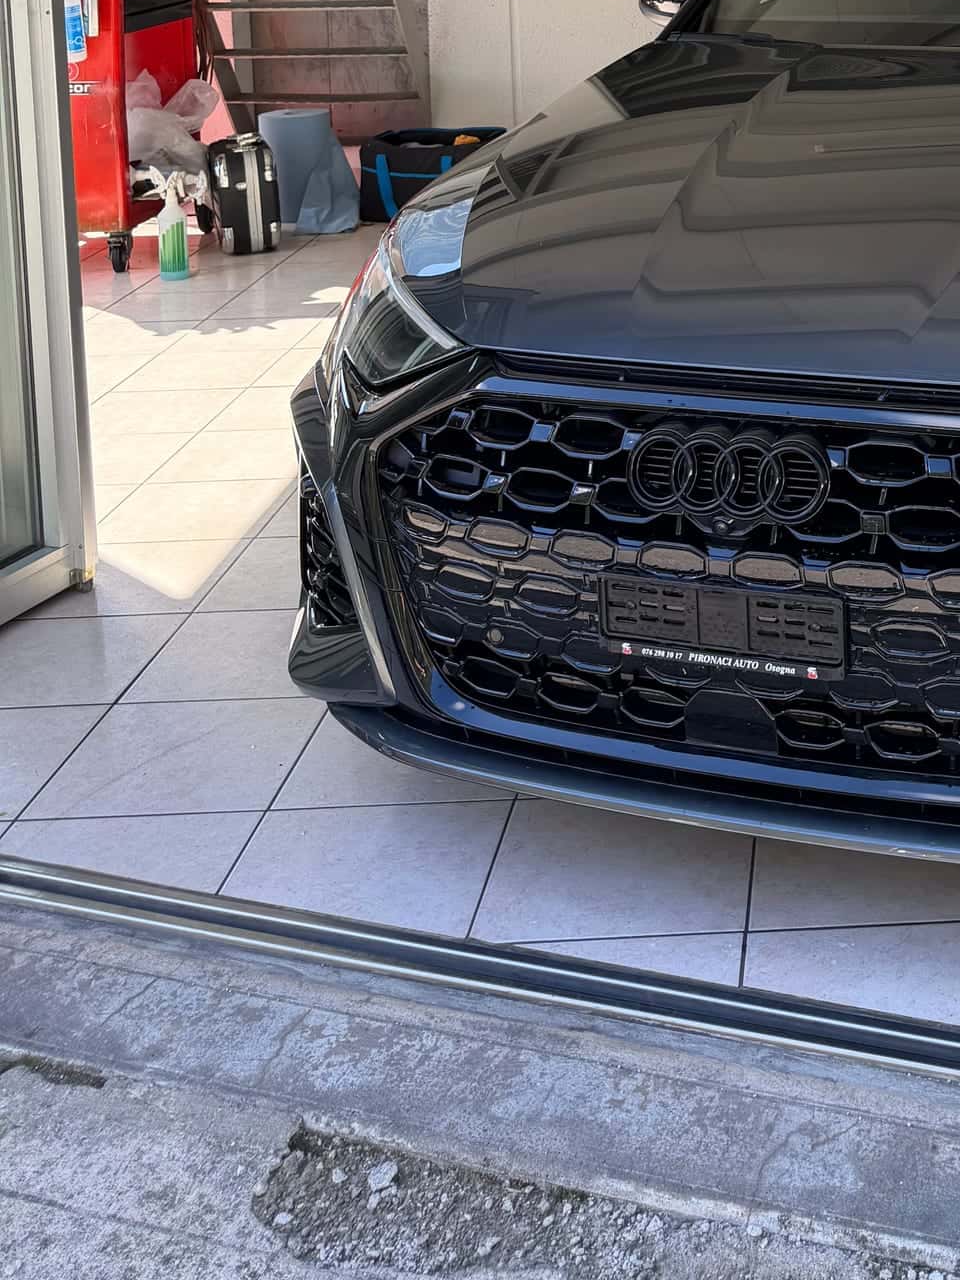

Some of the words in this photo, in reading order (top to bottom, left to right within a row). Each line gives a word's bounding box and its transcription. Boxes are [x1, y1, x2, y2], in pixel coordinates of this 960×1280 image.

[688, 652, 732, 667] PIRONACI
[732, 660, 760, 671] AUTO
[764, 662, 796, 675] Osogna
